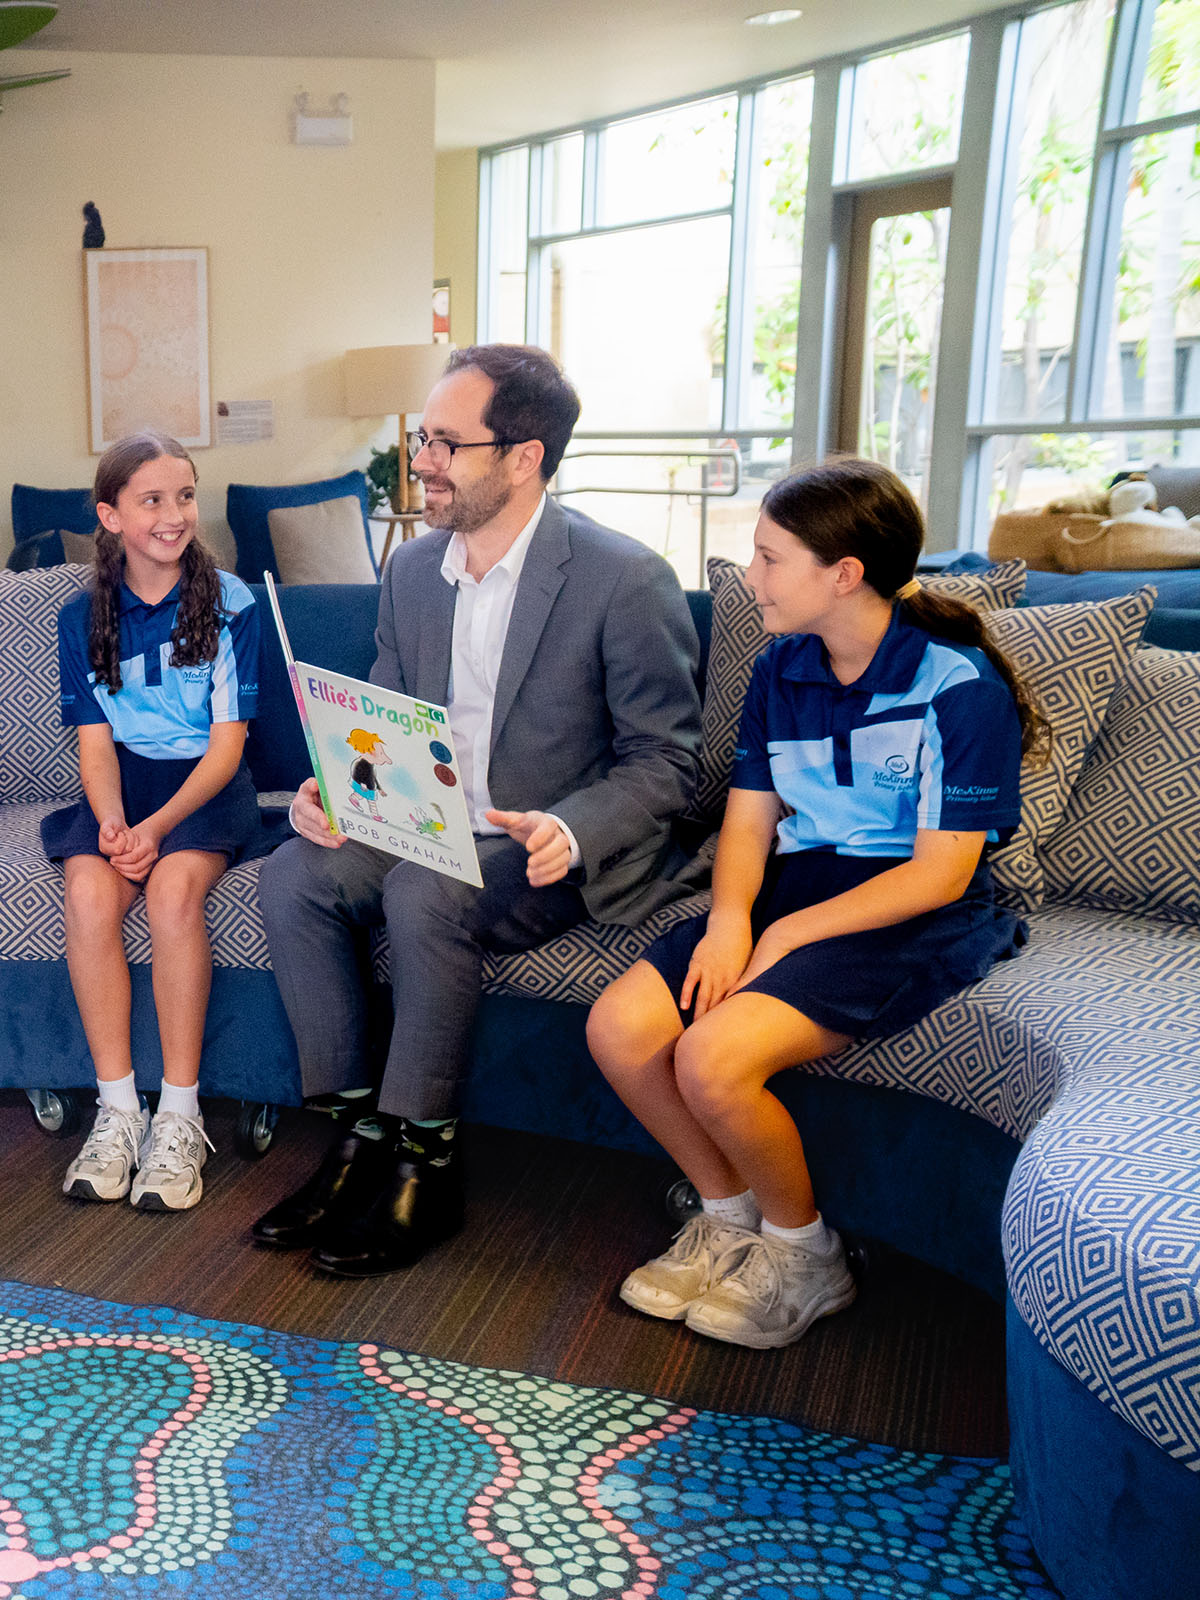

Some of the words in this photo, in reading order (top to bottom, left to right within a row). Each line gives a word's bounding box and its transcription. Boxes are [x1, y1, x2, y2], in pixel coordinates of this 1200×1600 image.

[307, 677, 358, 712] Ellie's
[360, 694, 439, 737] Dragon
[872, 771, 913, 783] McKinn
[346, 819, 380, 840] BOB
[388, 835, 462, 872] GRAHAM
